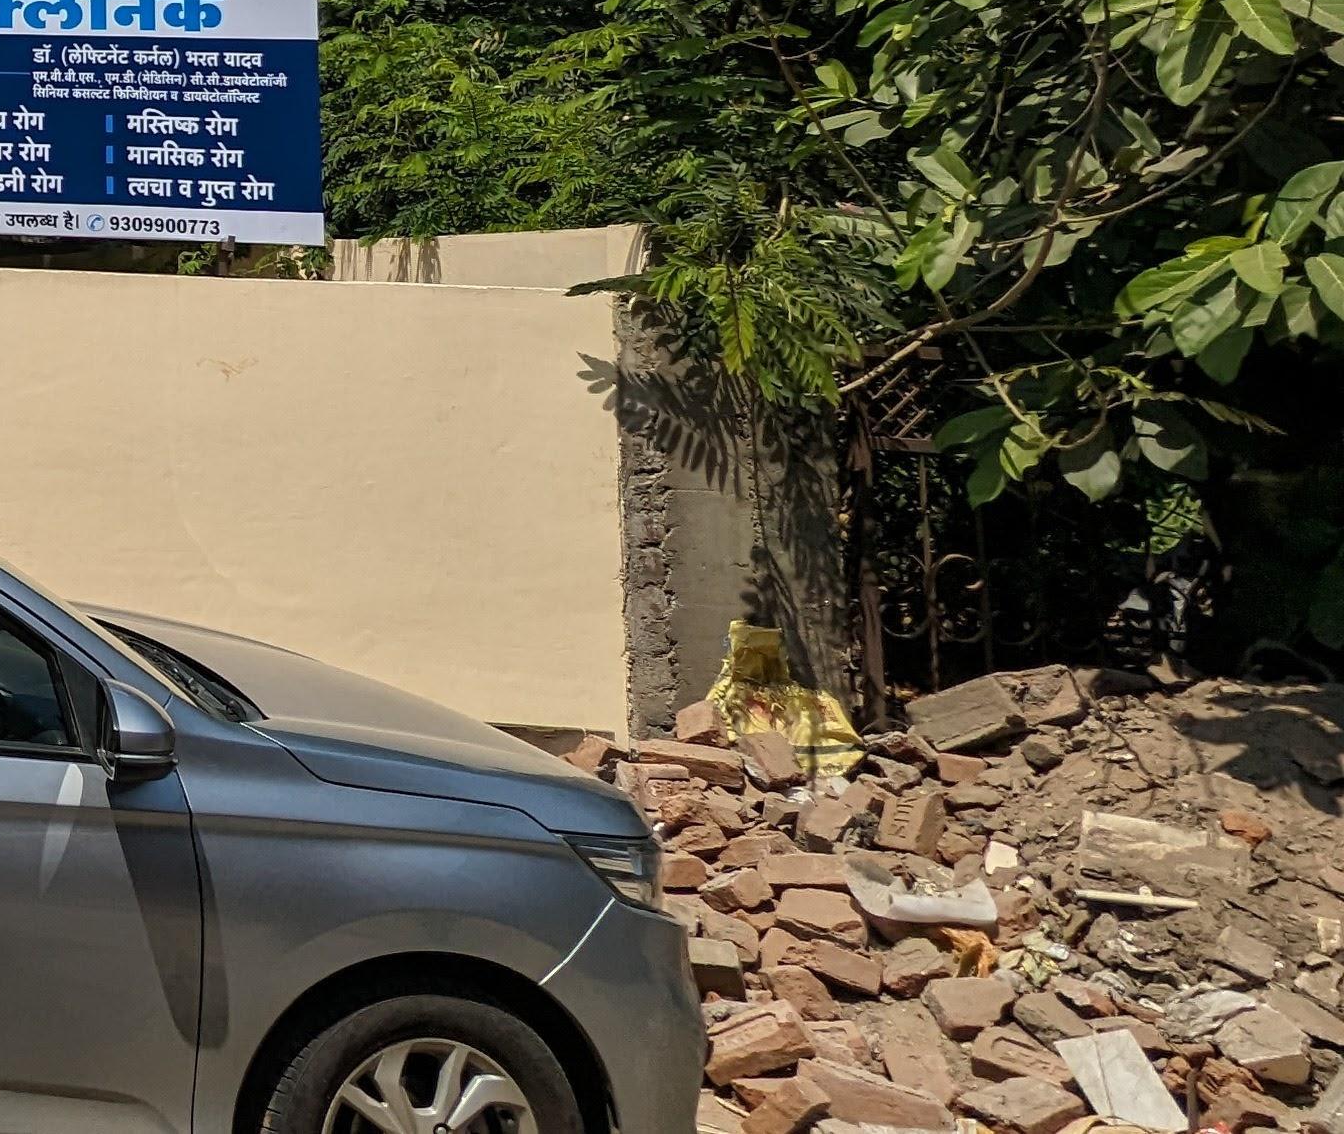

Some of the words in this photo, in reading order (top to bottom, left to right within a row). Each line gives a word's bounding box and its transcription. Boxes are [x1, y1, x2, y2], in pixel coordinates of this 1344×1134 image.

[32, 44, 56, 63] डॉ.
[134, 45, 180, 67] कर्नल)
[185, 51, 219, 68] भरत
[223, 52, 264, 69] यादव
[32, 83, 70, 99] सिनियर
[113, 85, 168, 101] फिजिशियन
[170, 91, 179, 102] व
[12, 105, 45, 130] रोग
[126, 108, 200, 135] मस्तिष्क
[205, 110, 239, 137] रोग
[18, 135, 51, 162] रोग
[127, 140, 205, 167] मानसिक
[210, 142, 244, 168] रोग
[31, 167, 64, 193] रोग
[127, 177, 173, 197] त्वचा
[178, 179, 193, 198] व
[198, 180, 236, 207] गुप्त
[241, 174, 275, 201] रोग
[5, 213, 59, 228] उपलब्ध
[109, 216, 221, 236] 9309900773
